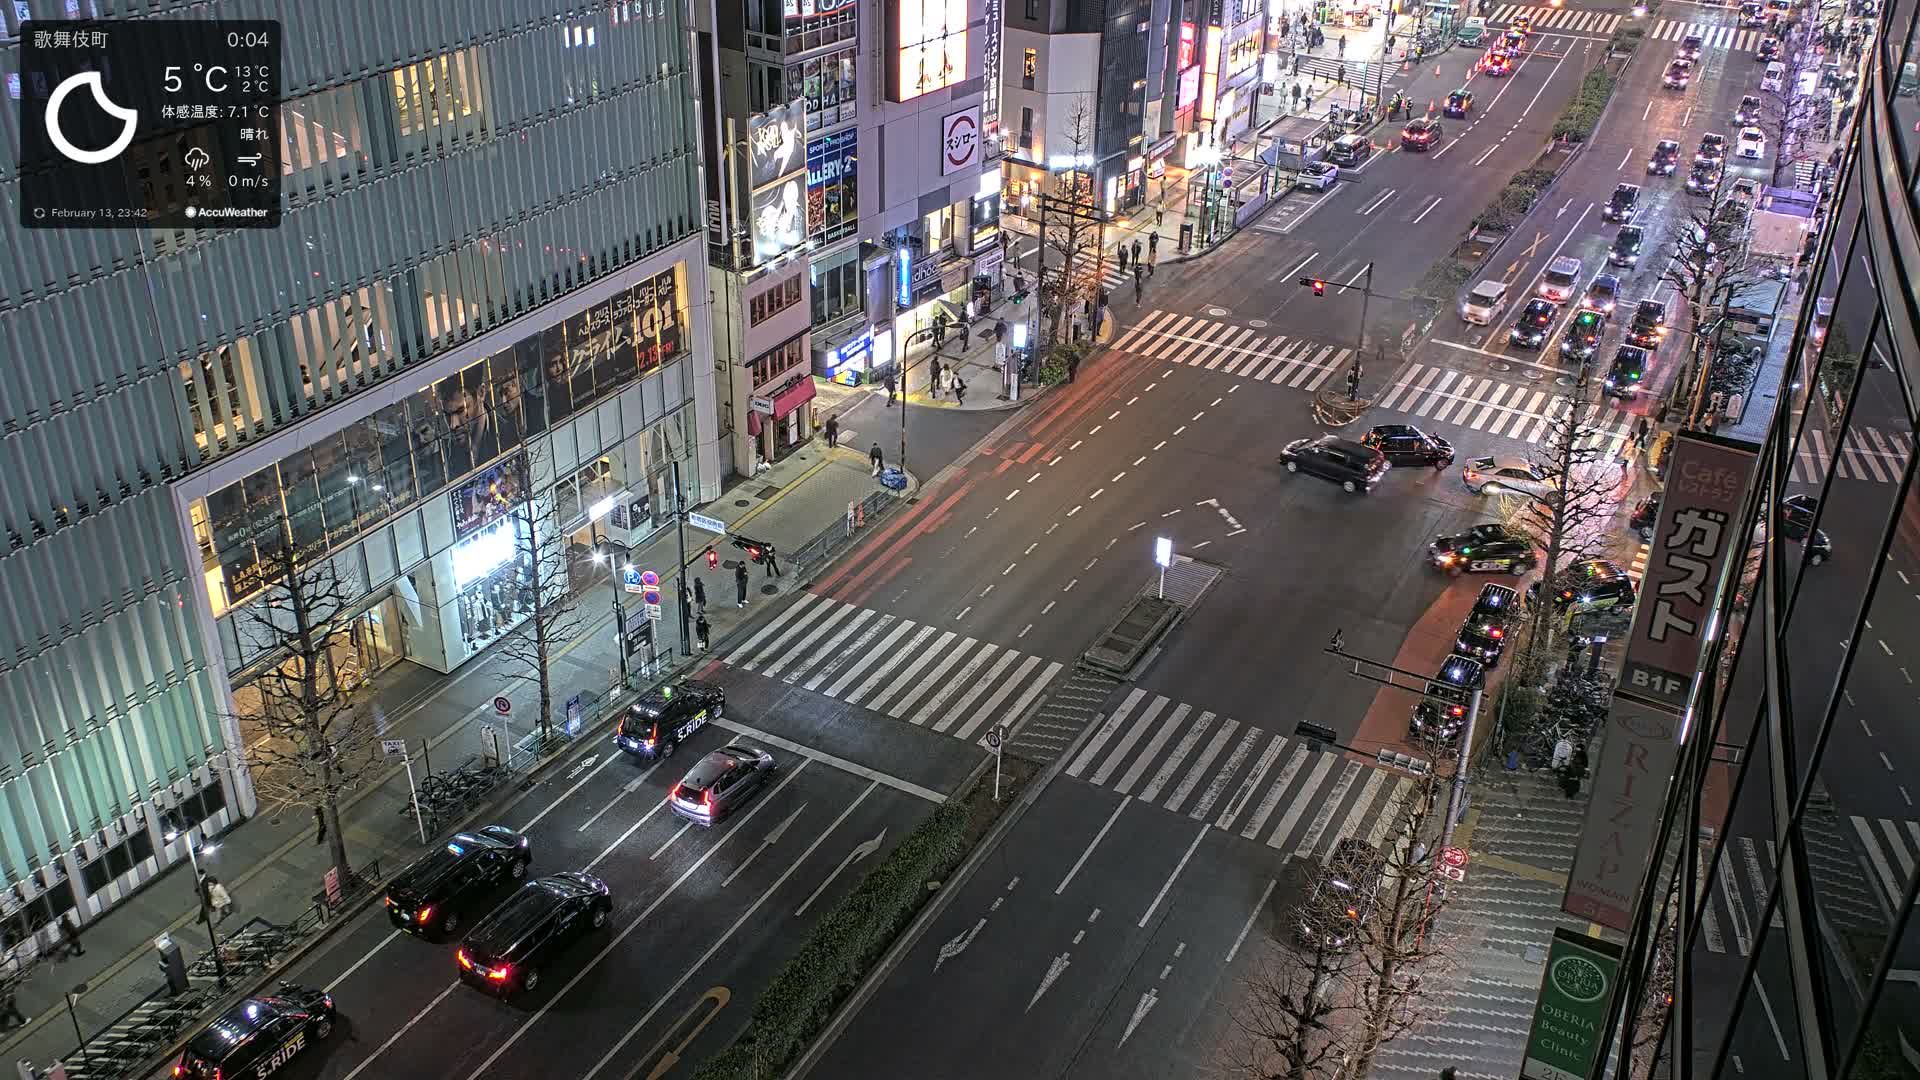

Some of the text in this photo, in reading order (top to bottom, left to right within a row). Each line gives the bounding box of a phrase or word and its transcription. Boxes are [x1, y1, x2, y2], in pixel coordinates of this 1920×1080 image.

[946, 132, 977, 151] スシロー
[708, 199, 721, 233] MUJI
[594, 306, 610, 321] クリス
[613, 305, 633, 320] ラファロ
[616, 295, 632, 308] マーク
[631, 299, 675, 348] 101
[639, 344, 658, 369] 2.13
[1649, 508, 1729, 642] ガスト
[1631, 669, 1681, 695] B1F
[677, 712, 707, 742] S.RIDE
[1541, 1003, 1594, 1032] OBERIA
[1541, 1020, 1589, 1047] Beauty
[257, 1035, 306, 1080] S.RIDE
[1540, 1038, 1583, 1061] Clinic
